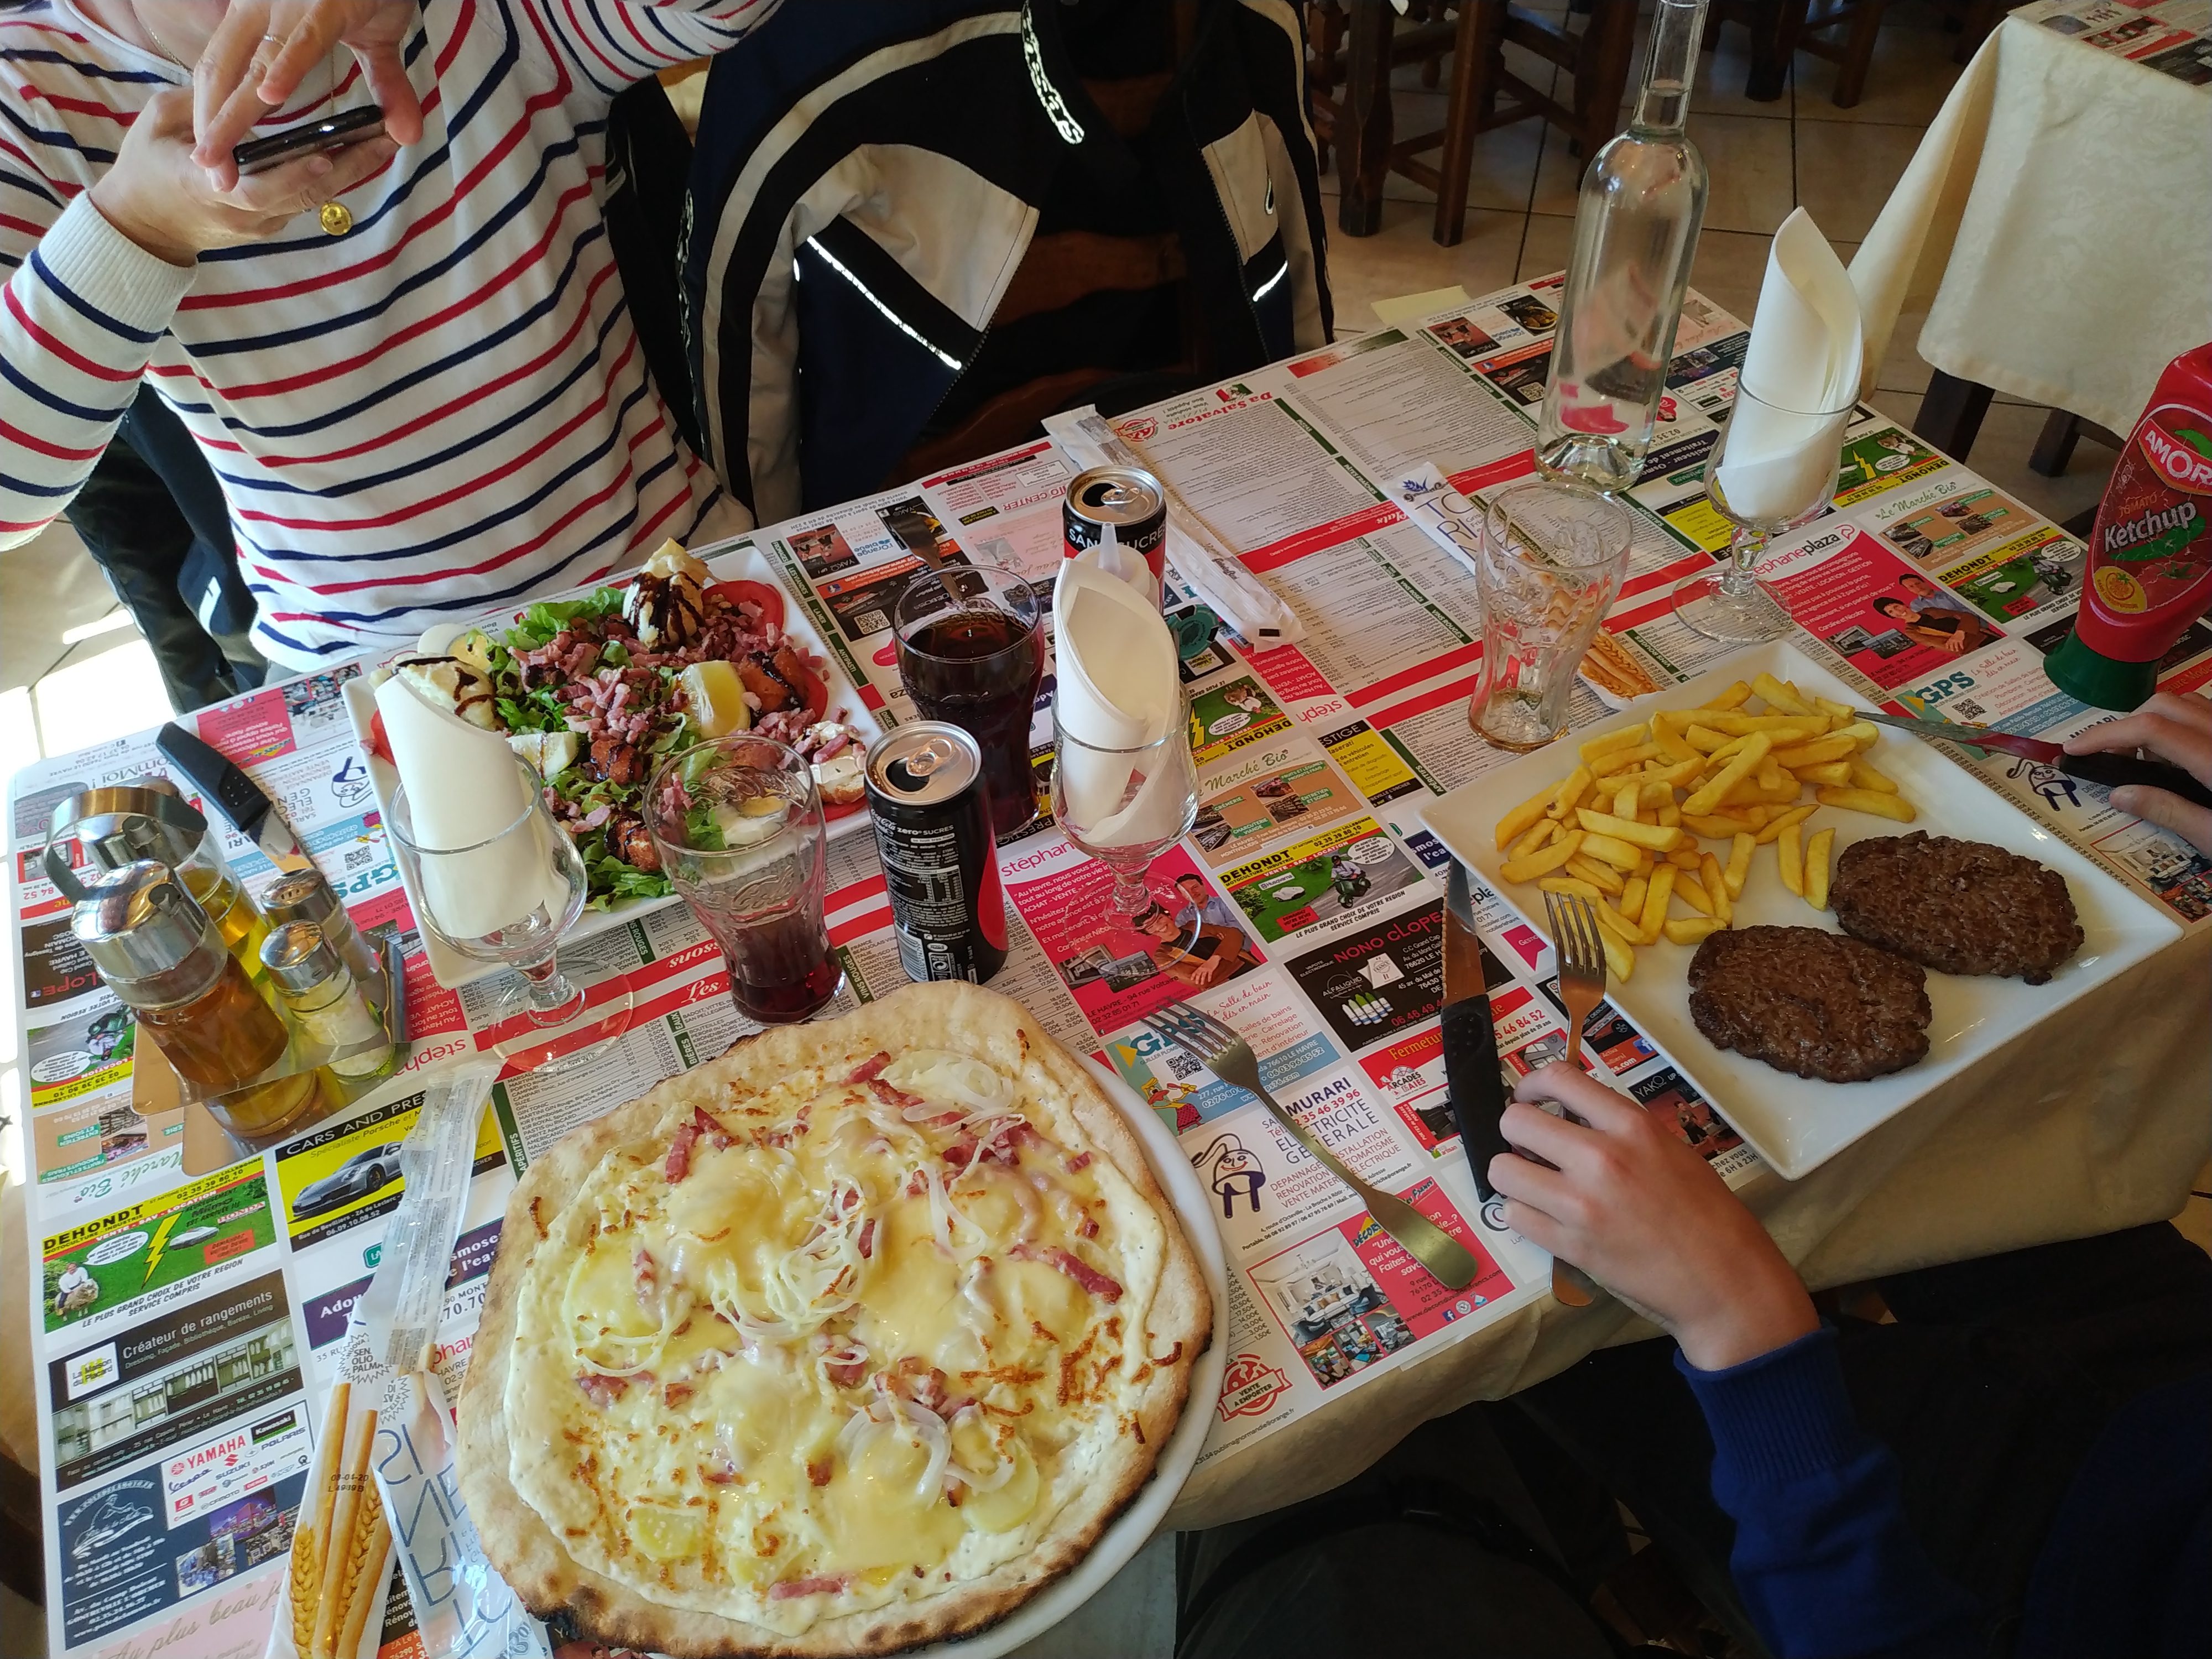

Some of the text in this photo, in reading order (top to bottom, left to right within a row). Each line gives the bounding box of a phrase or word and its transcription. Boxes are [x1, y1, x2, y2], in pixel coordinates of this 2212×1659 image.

[1167, 391, 1272, 430] Da Salvatore
[2104, 501, 2197, 552] Ketchup
[1937, 554, 1992, 582] DEHONDT
[838, 648, 857, 672] ANTIPASTI
[1916, 671, 1975, 703] GPS
[1205, 760, 1260, 791] Marché
[1415, 764, 1443, 792] APÉRITIFS
[923, 825, 954, 835] SUCRES
[1233, 818, 1268, 834] CHARCUTERIE
[1220, 849, 1291, 883] DEHONDT
[1264, 865, 1289, 878] VENTE
[1293, 857, 1308, 867] SAV
[1313, 841, 1349, 858] LOCATION
[1018, 865, 1090, 898] Au Havre, nous vous
[1024, 888, 1077, 914] ACHAT VENTE
[1304, 926, 1318, 935] PLUS
[1319, 918, 1338, 928] GRAND
[1339, 910, 1357, 921] CHOIX
[1366, 900, 1384, 910] VOTRE
[1385, 890, 1406, 902] REGION
[1331, 908, 1380, 931] SERVICE COMPRIS
[851, 940, 872, 950] FRANCE
[1333, 938, 1384, 963] NONO
[1413, 938, 1429, 948] Grand
[1419, 946, 1431, 955] Mont
[1404, 958, 1426, 969] 76620
[843, 954, 870, 999] VINS ROUGES
[869, 974, 891, 985] BAROLO
[1323, 977, 1363, 997] ALFALIQUID
[1418, 978, 1439, 989] 76430
[681, 980, 719, 1004] Les
[1097, 999, 1123, 1013] HAVRE
[1150, 975, 1179, 990] Voltaire
[1219, 995, 1241, 1010] Salle
[1243, 990, 1253, 998] de
[1252, 981, 1272, 993] bain
[1249, 993, 1271, 1006] main
[671, 1012, 684, 1030] EAUX
[689, 1019, 724, 1034] BOUTEILLES
[1239, 1020, 1261, 1035] Salles
[1272, 1005, 1292, 1018] bains
[1261, 1013, 1298, 1034] Carrelage
[1504, 1009, 1546, 1035] 46 84 52
[1261, 1021, 1304, 1044] Rénovation
[1271, 1029, 1309, 1051] d'intérieur
[697, 1040, 726, 1052] PRESSION
[1266, 1055, 1288, 1068] 76610
[1296, 1039, 1319, 1054] HAVRE
[1267, 1070, 1280, 1078] 06
[1279, 1064, 1291, 1072] 03
[1291, 1058, 1301, 1067] 96
[1312, 1047, 1324, 1056] 52
[512, 1084, 539, 1097] CAMPARI
[1285, 1077, 1352, 1117] MURARI
[1633, 1074, 1666, 1099] YAKO
[1301, 1089, 1360, 1123] 35 46 39 96
[553, 1114, 577, 1126] RICARD
[286, 1112, 384, 1155] CARS AND
[311, 1114, 413, 1157] Spécialiste Porsche et
[1730, 1148, 1748, 1161] vous
[1743, 1151, 1759, 1167] 23H
[1276, 1170, 1330, 1200] RENOVATION
[1281, 1192, 1311, 1209] VENTE
[43, 1204, 144, 1250] DEHONDT
[1241, 1238, 1265, 1251] Portable.
[1379, 1257, 1406, 1273] Faites
[1410, 1283, 1432, 1296] 76170
[1235, 1304, 1256, 1317] 17,50€
[1238, 1311, 1259, 1324] 14,00€
[123, 1290, 273, 1359] Créateur de rangements
[1255, 1329, 1271, 1342] 1,50€
[352, 1356, 373, 1365] OLIO
[1238, 1381, 1261, 1397] VENTE
[1241, 1383, 1274, 1404] EMPORTER
[261, 1427, 306, 1451] POLARIS
[187, 1434, 247, 1469] YAMAHA
[215, 1460, 251, 1480] SUZUKI
[209, 1594, 262, 1626] beau
